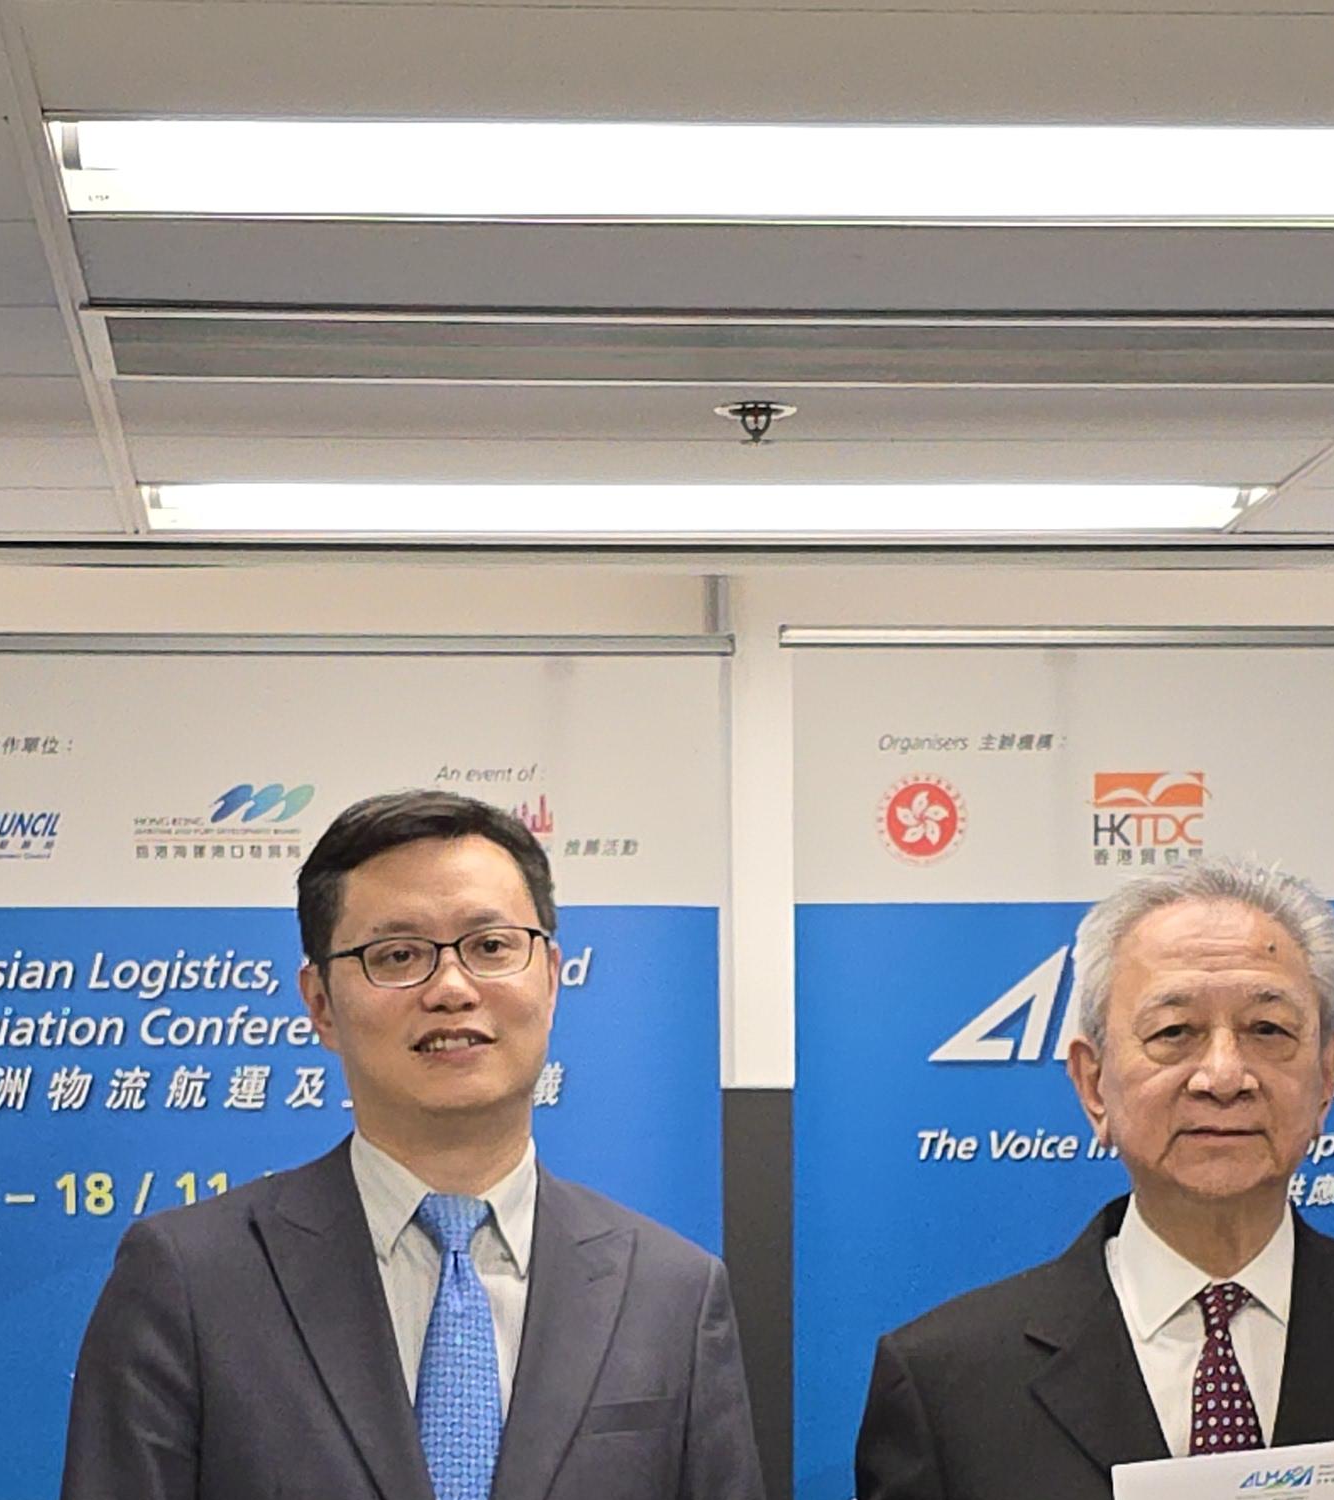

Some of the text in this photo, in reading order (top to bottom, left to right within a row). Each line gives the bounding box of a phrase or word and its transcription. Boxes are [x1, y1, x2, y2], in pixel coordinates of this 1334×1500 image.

[878, 733, 969, 754] Organisers
[435, 763, 537, 786] An event of
[1093, 813, 1204, 846] HKTDC
[88, 951, 280, 999] Logistics,
[139, 1007, 320, 1049] Confere
[918, 1130, 978, 1160] The
[989, 1130, 1079, 1161] Voice
[55, 1172, 114, 1217] 18
